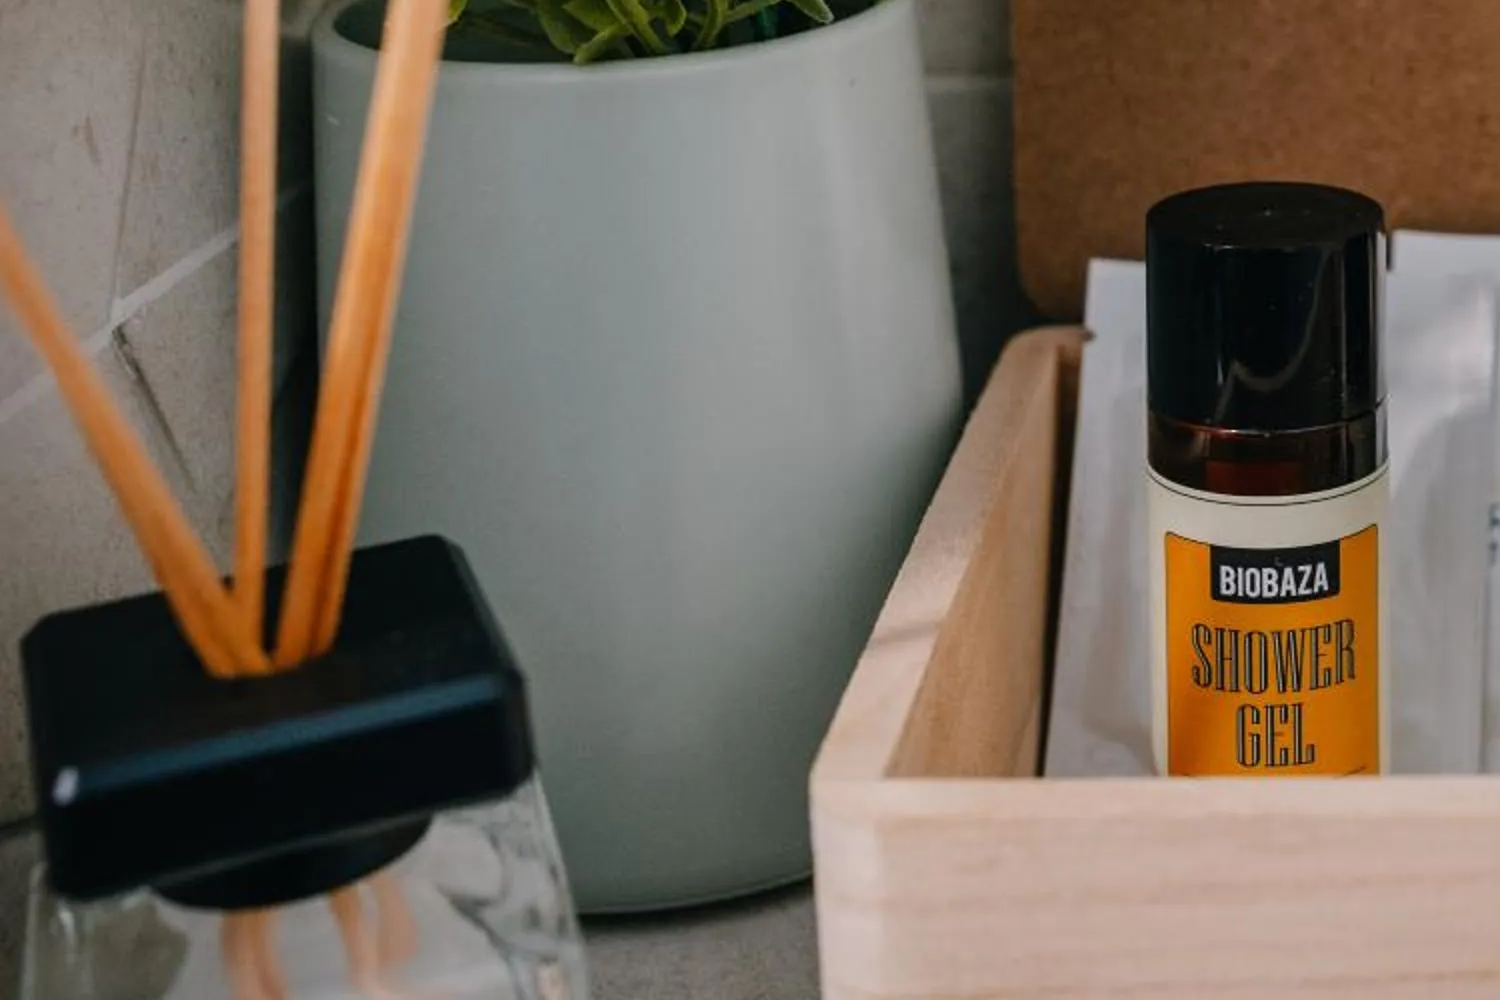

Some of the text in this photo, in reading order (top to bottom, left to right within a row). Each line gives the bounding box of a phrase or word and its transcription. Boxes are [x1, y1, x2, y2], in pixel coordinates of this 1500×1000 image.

[1219, 562, 1329, 598] BIOBAZA
[1191, 619, 1357, 694] SHOWER
[1236, 702, 1316, 767] GEL
